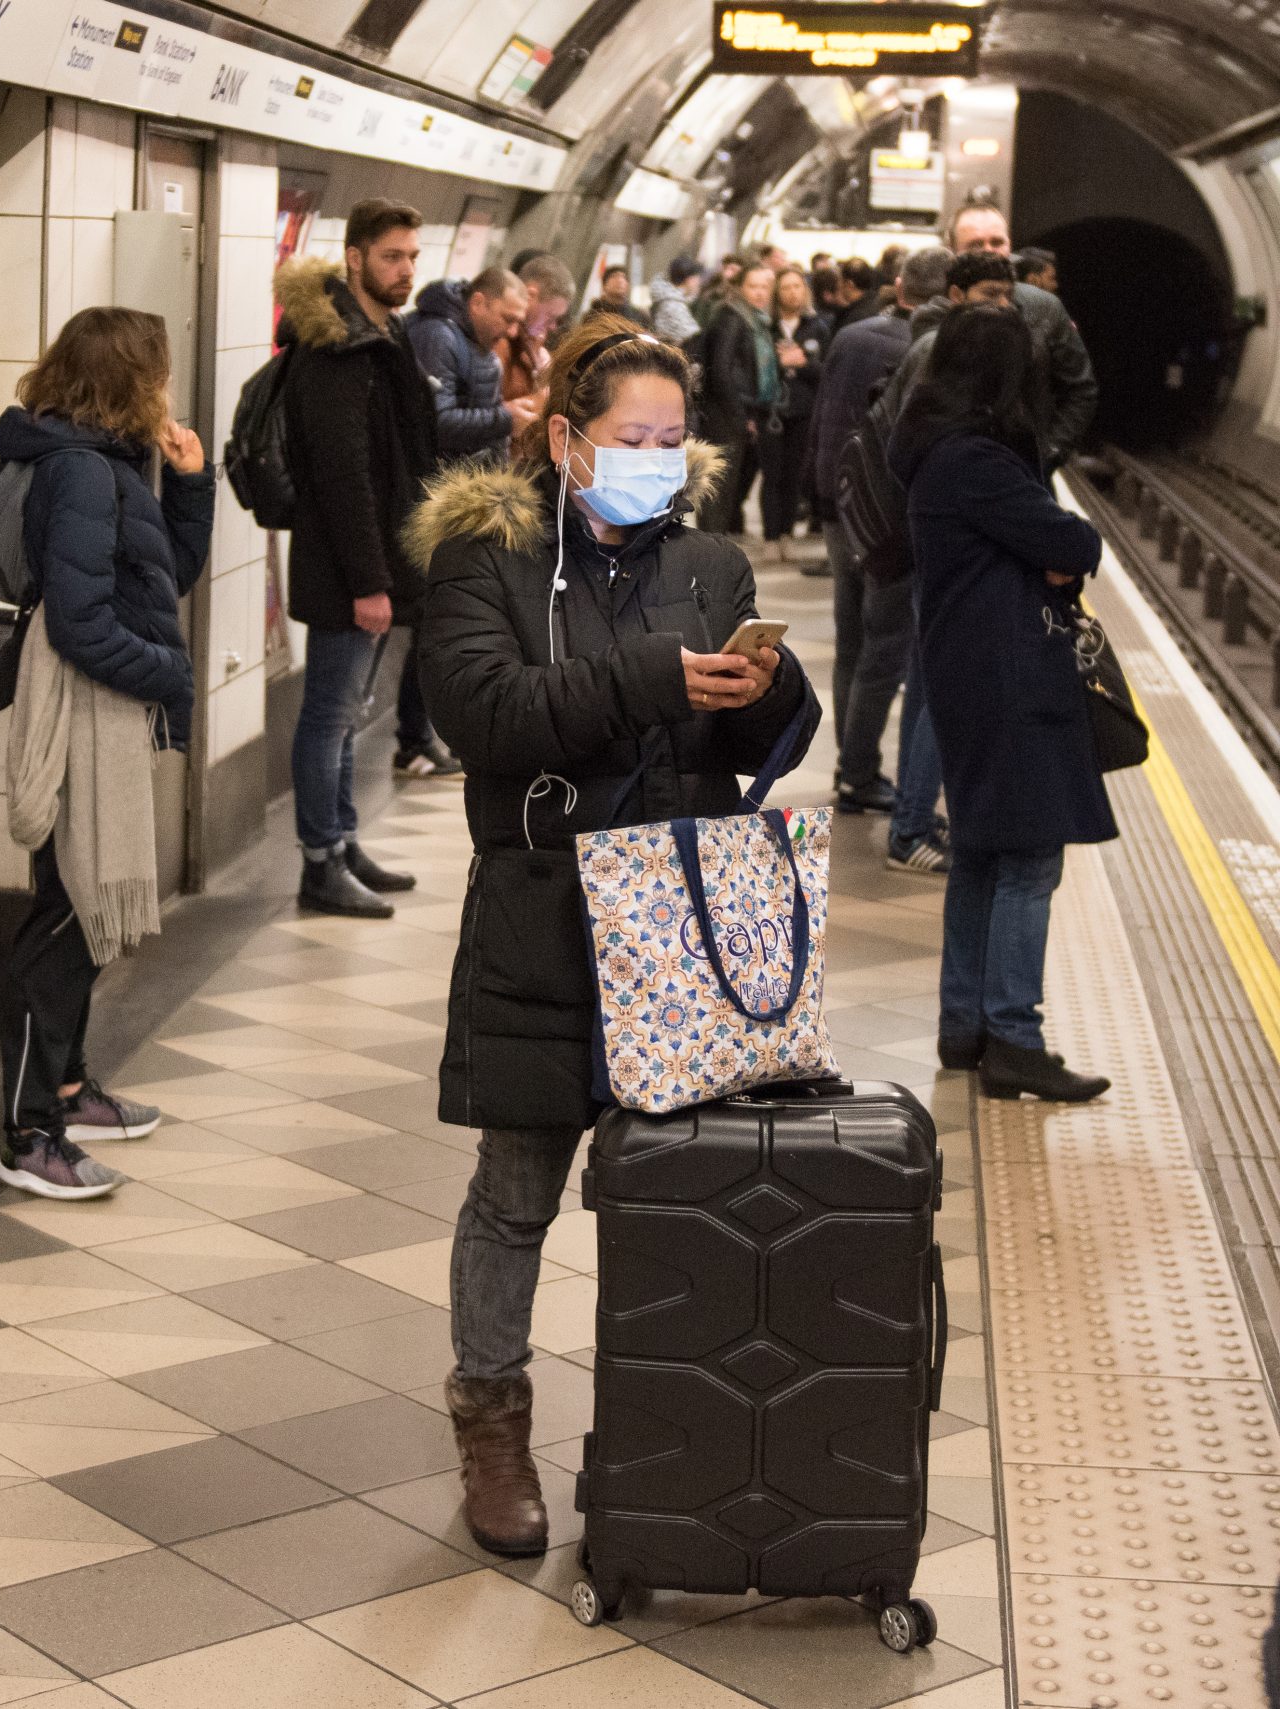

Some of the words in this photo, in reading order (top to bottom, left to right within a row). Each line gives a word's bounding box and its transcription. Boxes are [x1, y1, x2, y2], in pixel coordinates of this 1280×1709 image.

[78, 16, 116, 46] Monument
[67, 45, 94, 71] Station
[210, 64, 249, 106] BANK
[680, 905, 793, 965] Capr
[738, 976, 790, 1000] Italia
